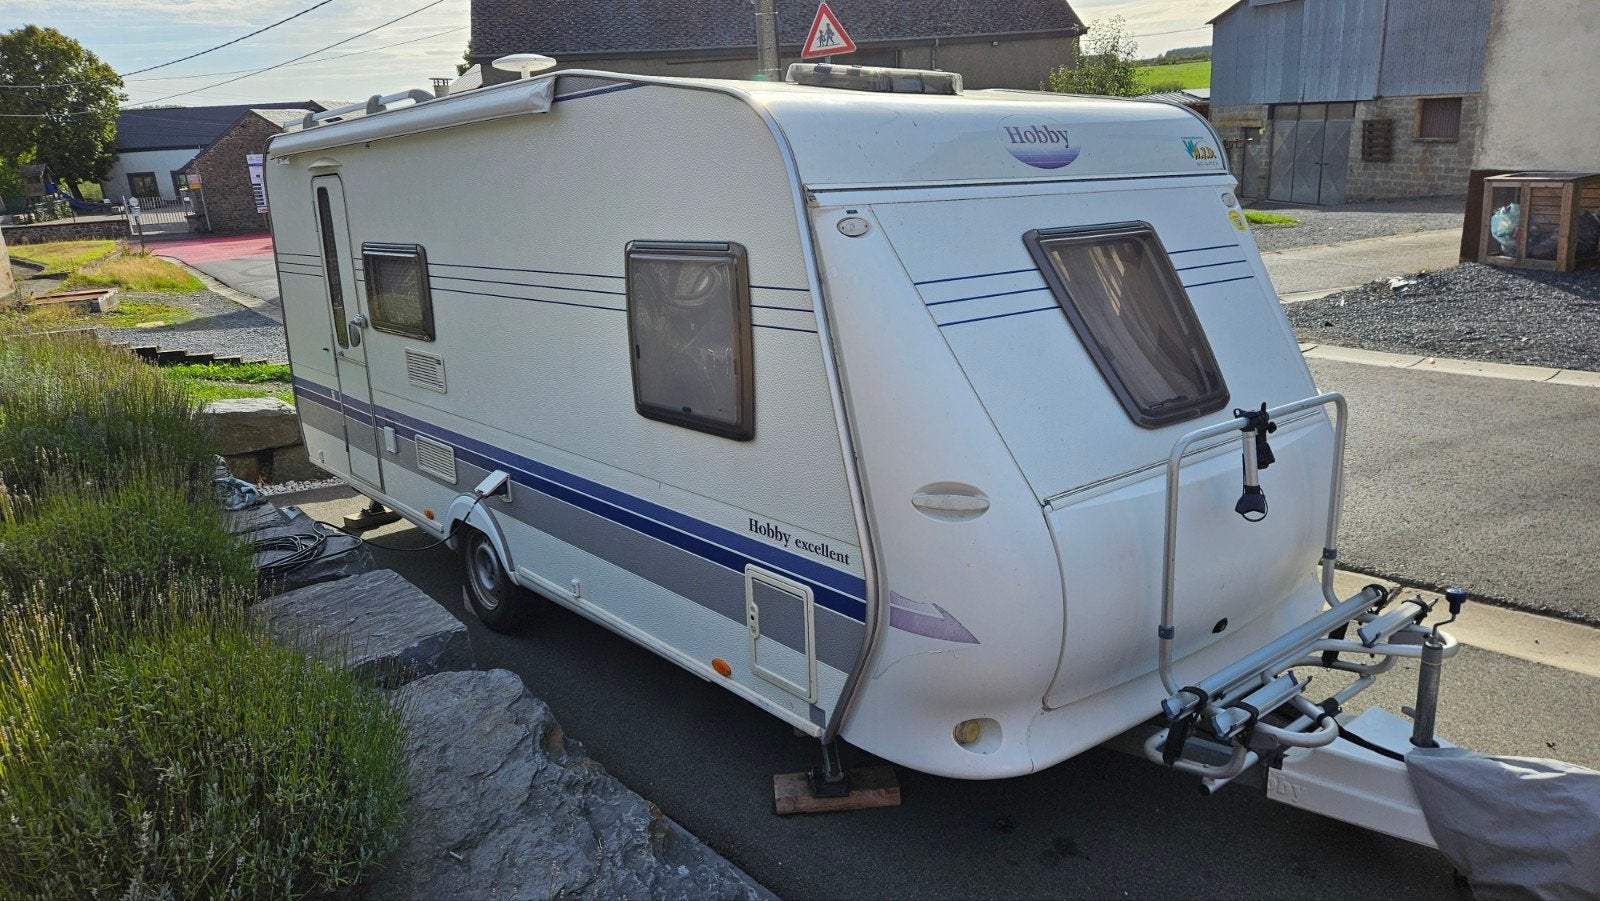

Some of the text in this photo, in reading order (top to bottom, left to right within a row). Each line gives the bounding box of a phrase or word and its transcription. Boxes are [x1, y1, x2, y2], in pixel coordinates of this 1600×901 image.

[1003, 125, 1069, 149] Hobby
[748, 518, 850, 565] Hobby excellent
